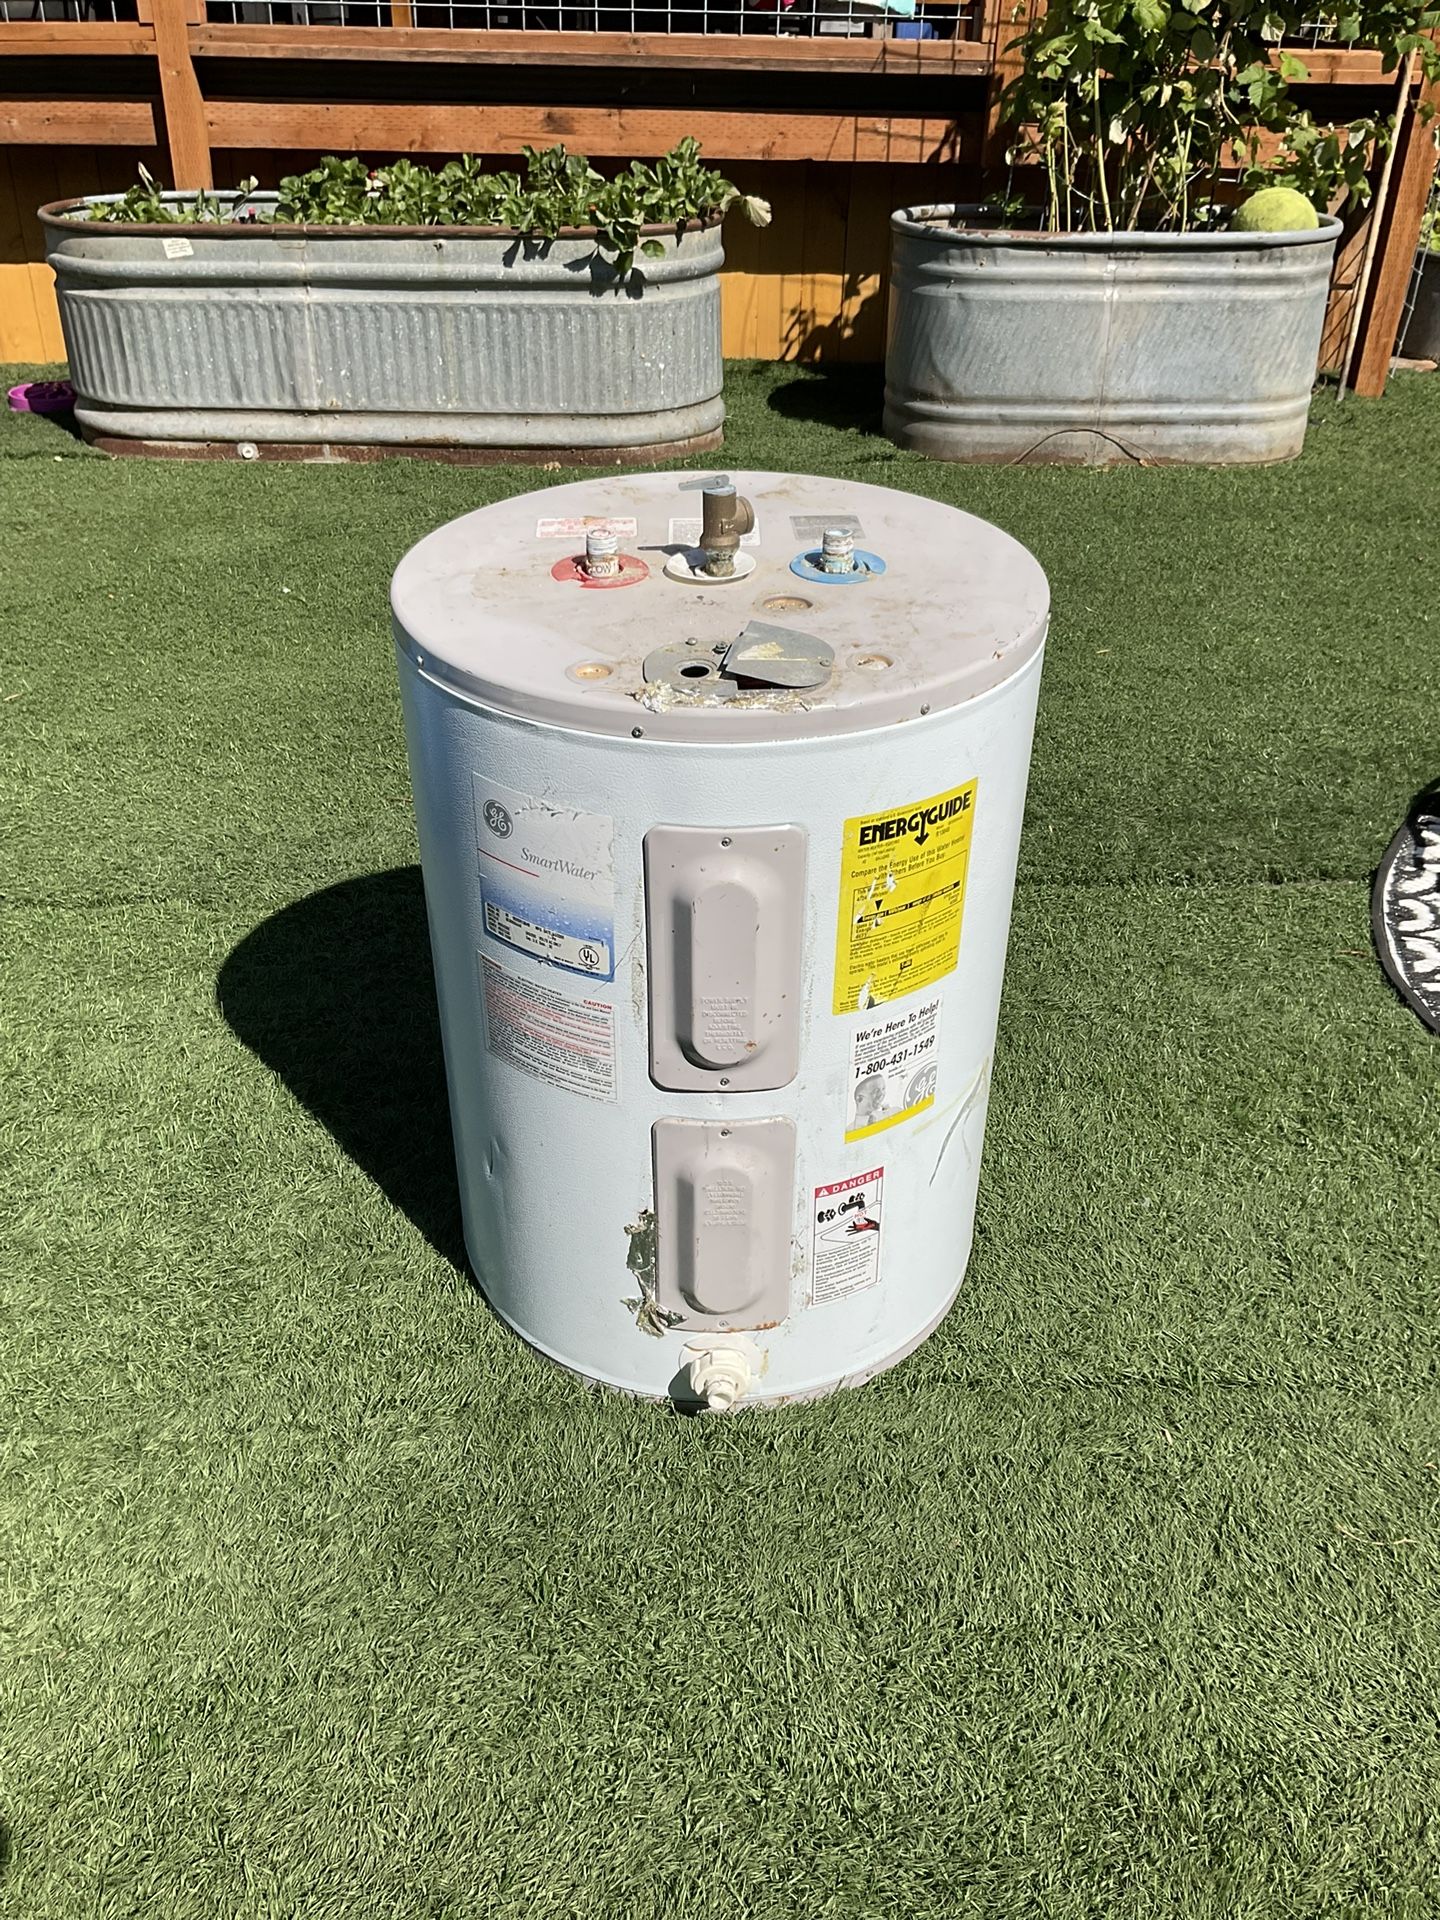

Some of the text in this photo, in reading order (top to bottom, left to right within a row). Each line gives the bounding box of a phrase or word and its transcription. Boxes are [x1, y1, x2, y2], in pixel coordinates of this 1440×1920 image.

[859, 789, 972, 847] ENERGYGUIDE
[520, 847, 598, 880] SmartWater
[851, 867, 877, 879] Compare
[878, 864, 887, 872] the
[889, 857, 908, 869] Energy
[909, 855, 919, 864] Use
[908, 862, 924, 872] Before
[926, 857, 935, 865] You
[583, 999, 612, 1011] CAUTION
[856, 999, 940, 1043] We're Here To Help!
[855, 1034, 936, 1079] 1-800-431-1549
[832, 1170, 880, 1194] DANGER
